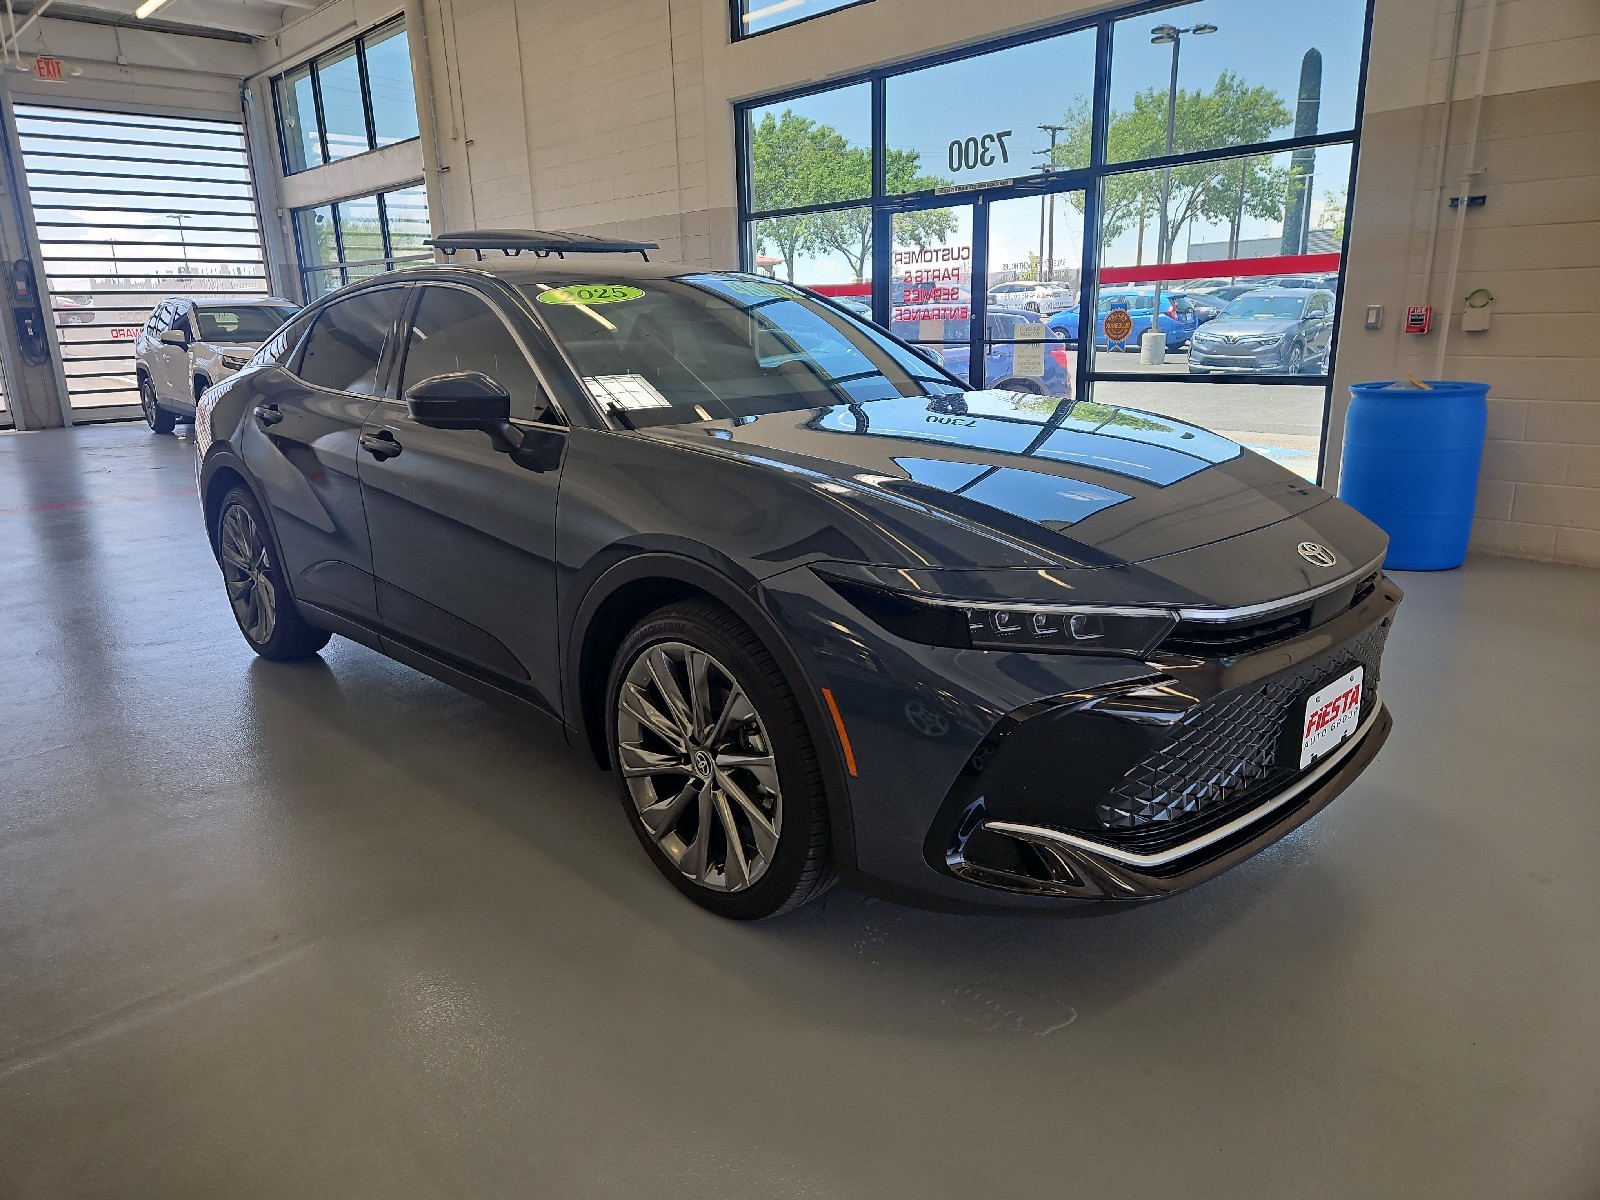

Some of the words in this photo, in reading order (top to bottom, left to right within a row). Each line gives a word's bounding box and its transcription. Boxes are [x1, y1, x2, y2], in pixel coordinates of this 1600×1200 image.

[36, 59, 63, 79] EXIT
[560, 287, 628, 302] 2025
[1409, 306, 1426, 314] FIRE
[1305, 684, 1360, 739] FIESTA
[1304, 728, 1327, 750] AUTO
[1330, 706, 1358, 732] GROUP
